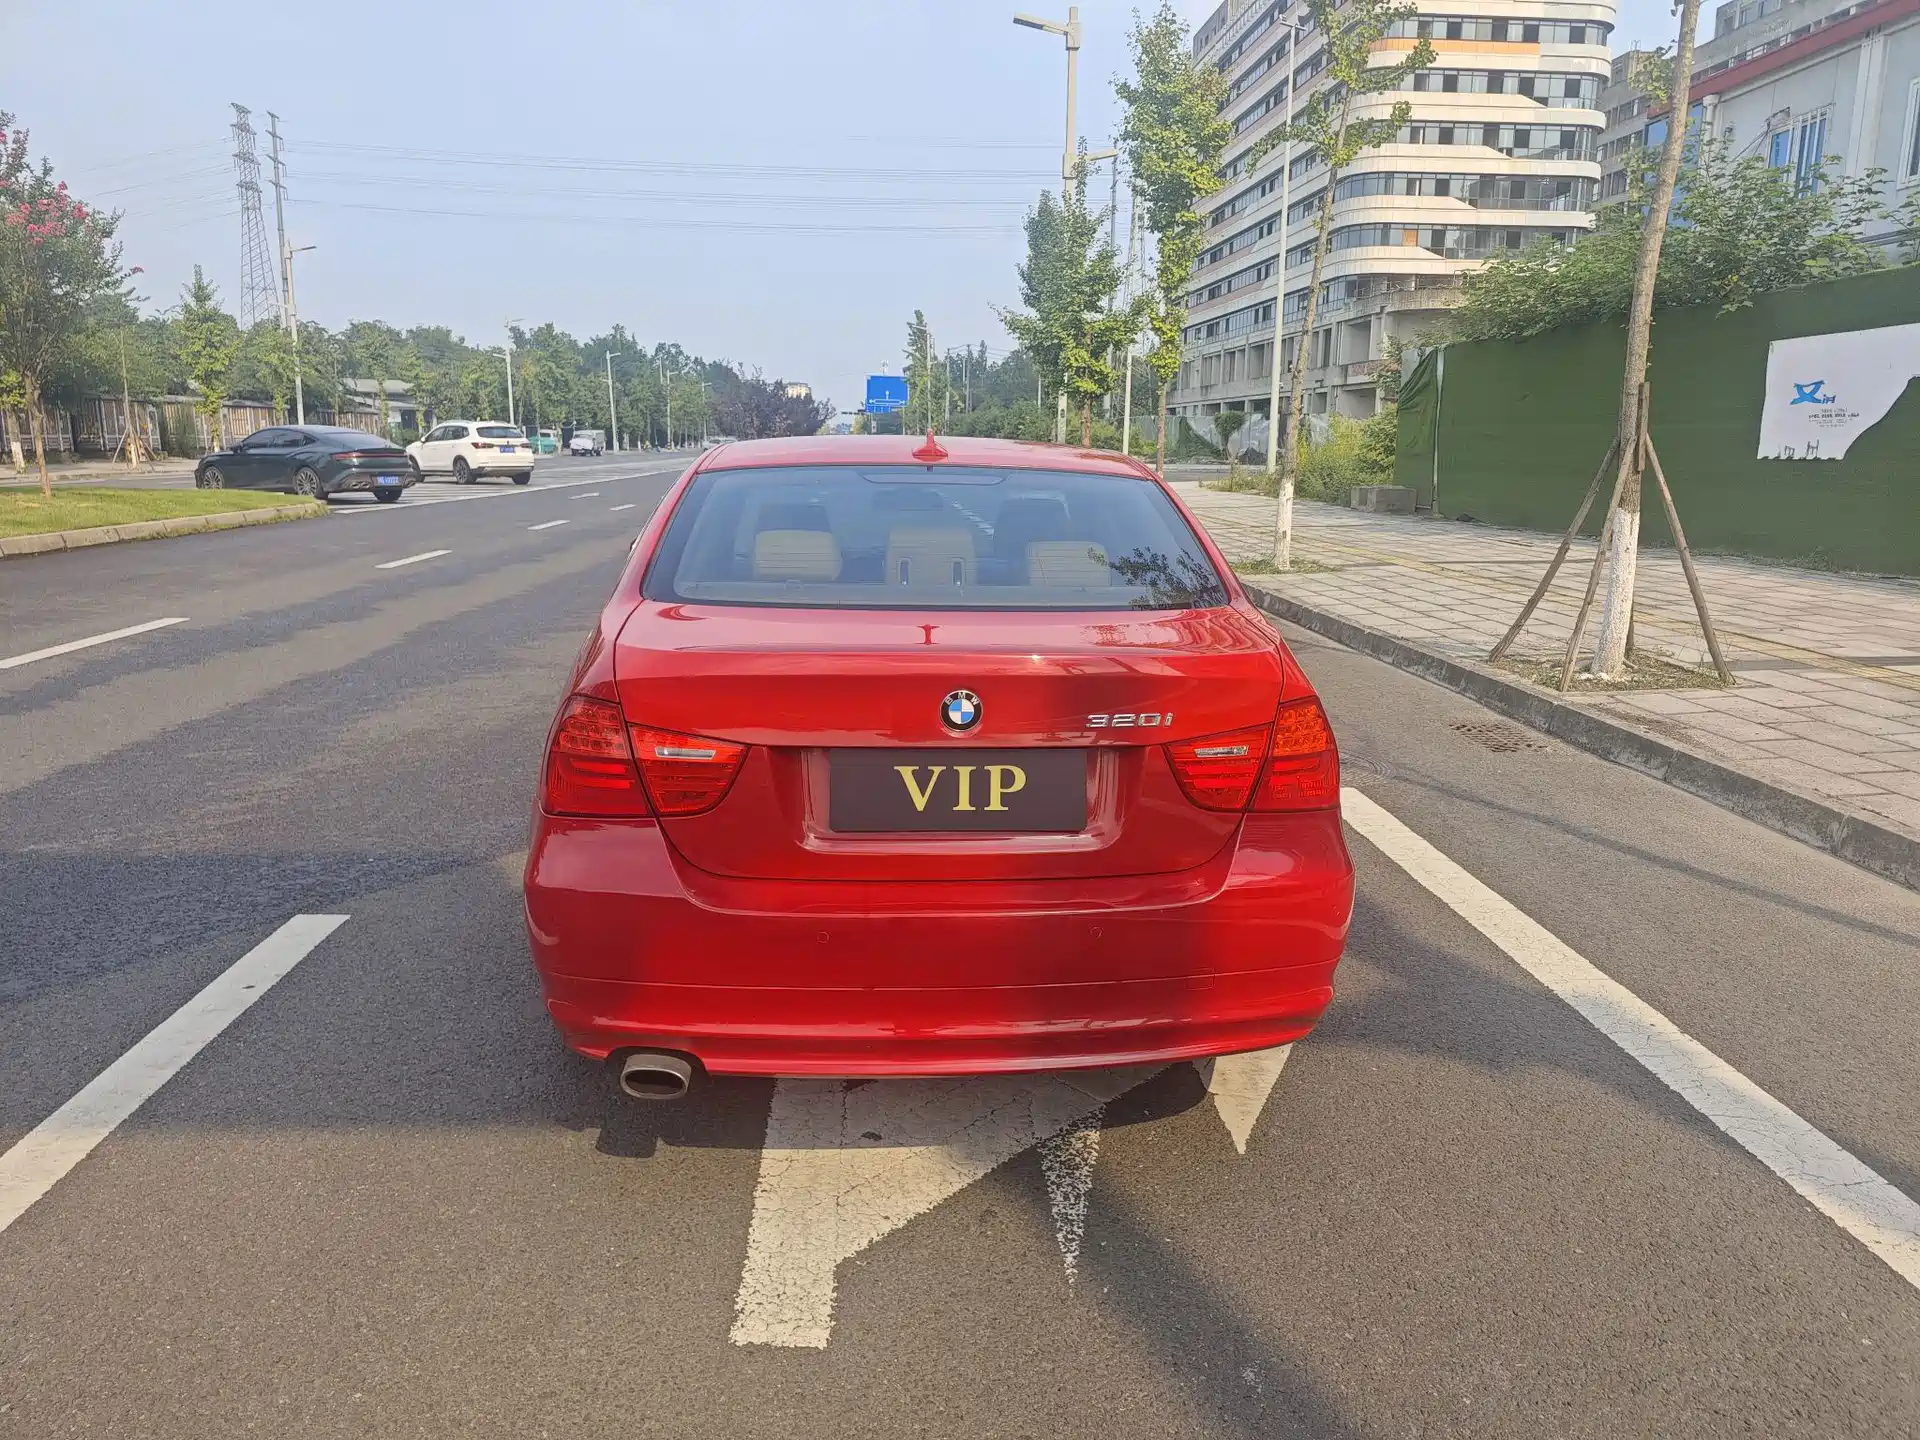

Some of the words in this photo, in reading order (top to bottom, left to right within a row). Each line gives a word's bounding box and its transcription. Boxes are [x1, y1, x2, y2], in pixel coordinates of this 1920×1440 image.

[944, 691, 981, 706] BMW
[1086, 712, 1174, 728] 320i
[893, 765, 1027, 811] VIP
